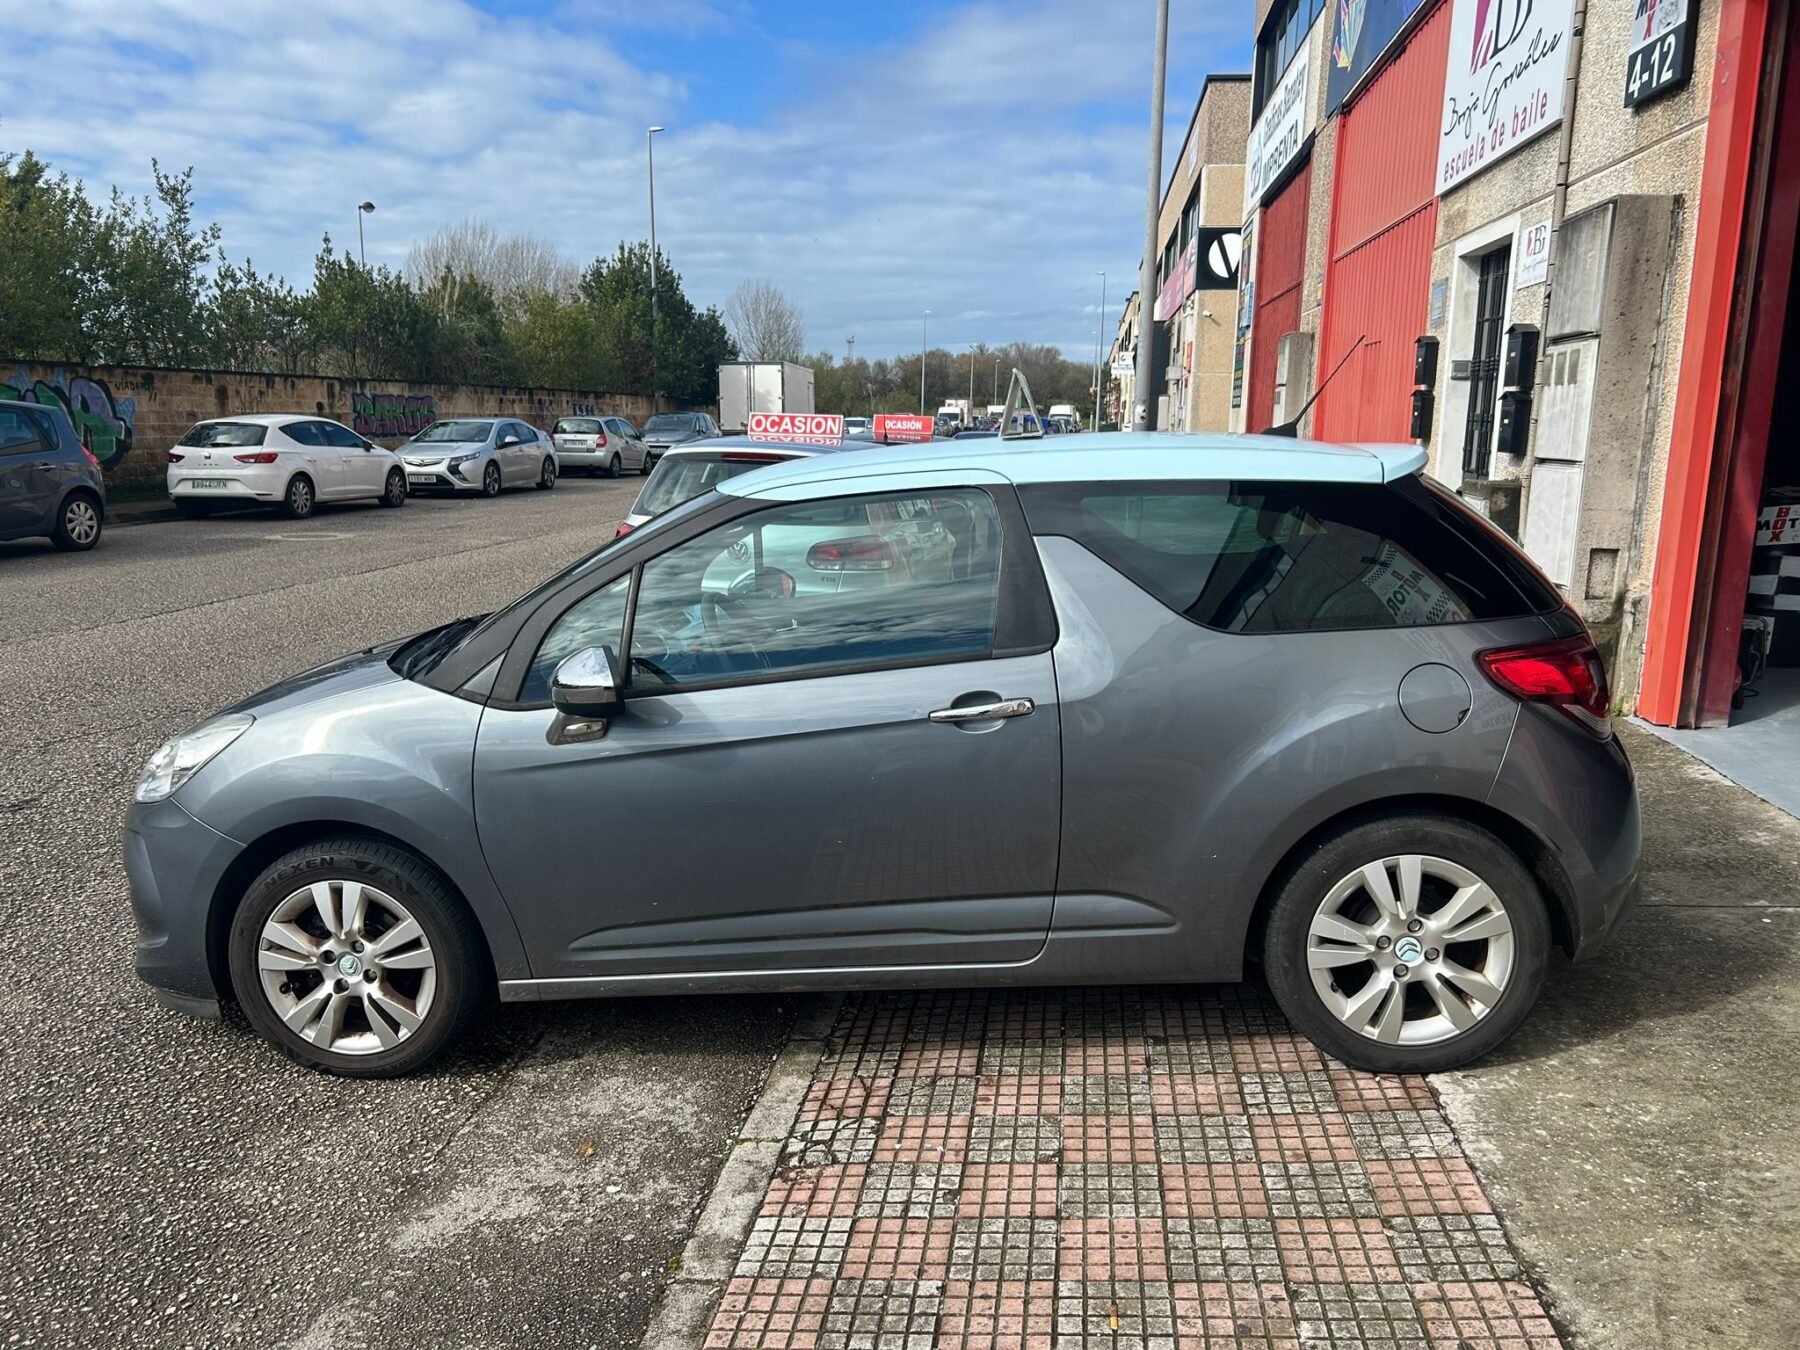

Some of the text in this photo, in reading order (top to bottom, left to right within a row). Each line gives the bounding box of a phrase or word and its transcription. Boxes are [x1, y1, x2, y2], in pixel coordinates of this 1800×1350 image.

[1628, 33, 1676, 99] 4-12
[1261, 118, 1298, 192] IMPRENTA
[1444, 88, 1548, 183] escuela de baile
[751, 415, 840, 434] OCASION
[1757, 517, 1800, 531] MOT
[264, 856, 335, 890] NEXEN
